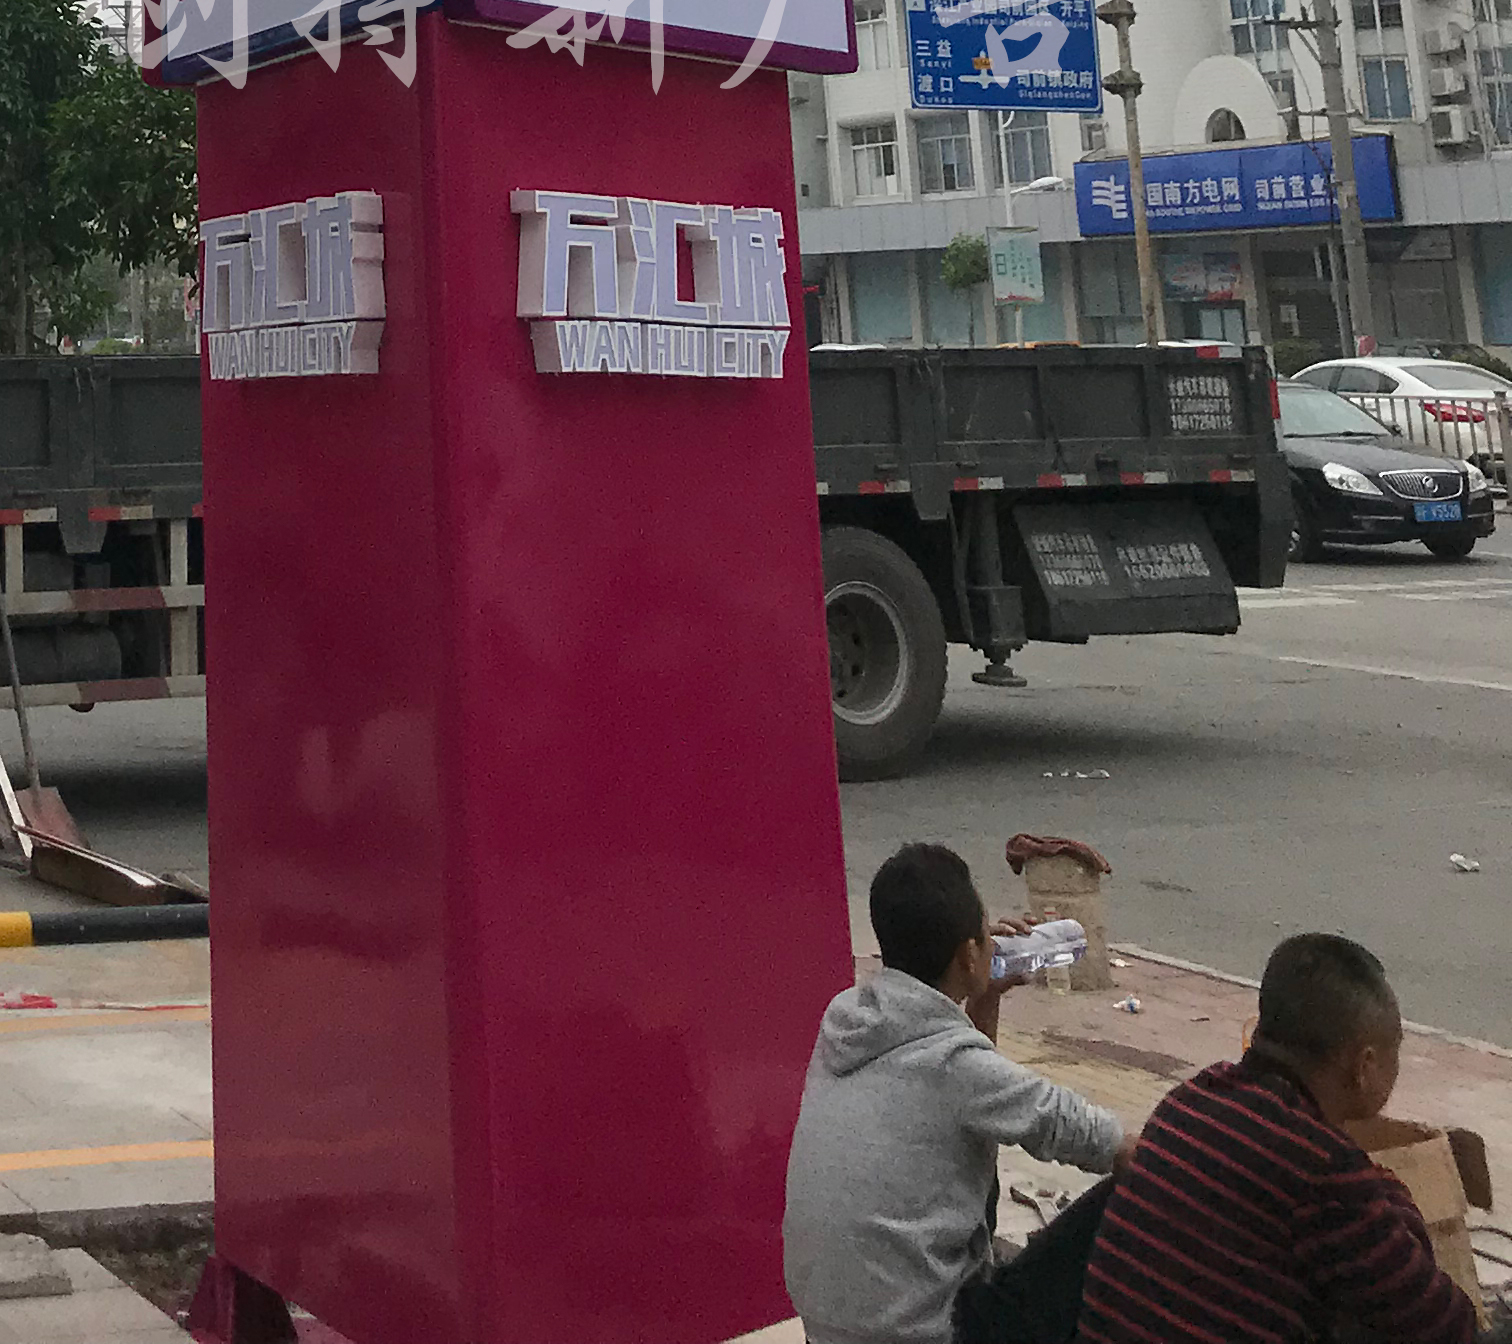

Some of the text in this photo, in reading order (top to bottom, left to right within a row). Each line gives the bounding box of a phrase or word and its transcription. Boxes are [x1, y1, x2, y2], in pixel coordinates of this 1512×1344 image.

[915, 39, 952, 58] 三益
[1145, 176, 1240, 207] 国南方电网
[200, 191, 368, 333] 万汇城
[533, 190, 790, 326] 万汇城
[208, 328, 257, 380] WAN
[300, 320, 356, 376] CITY
[555, 320, 790, 378] WAN HUI CITY
